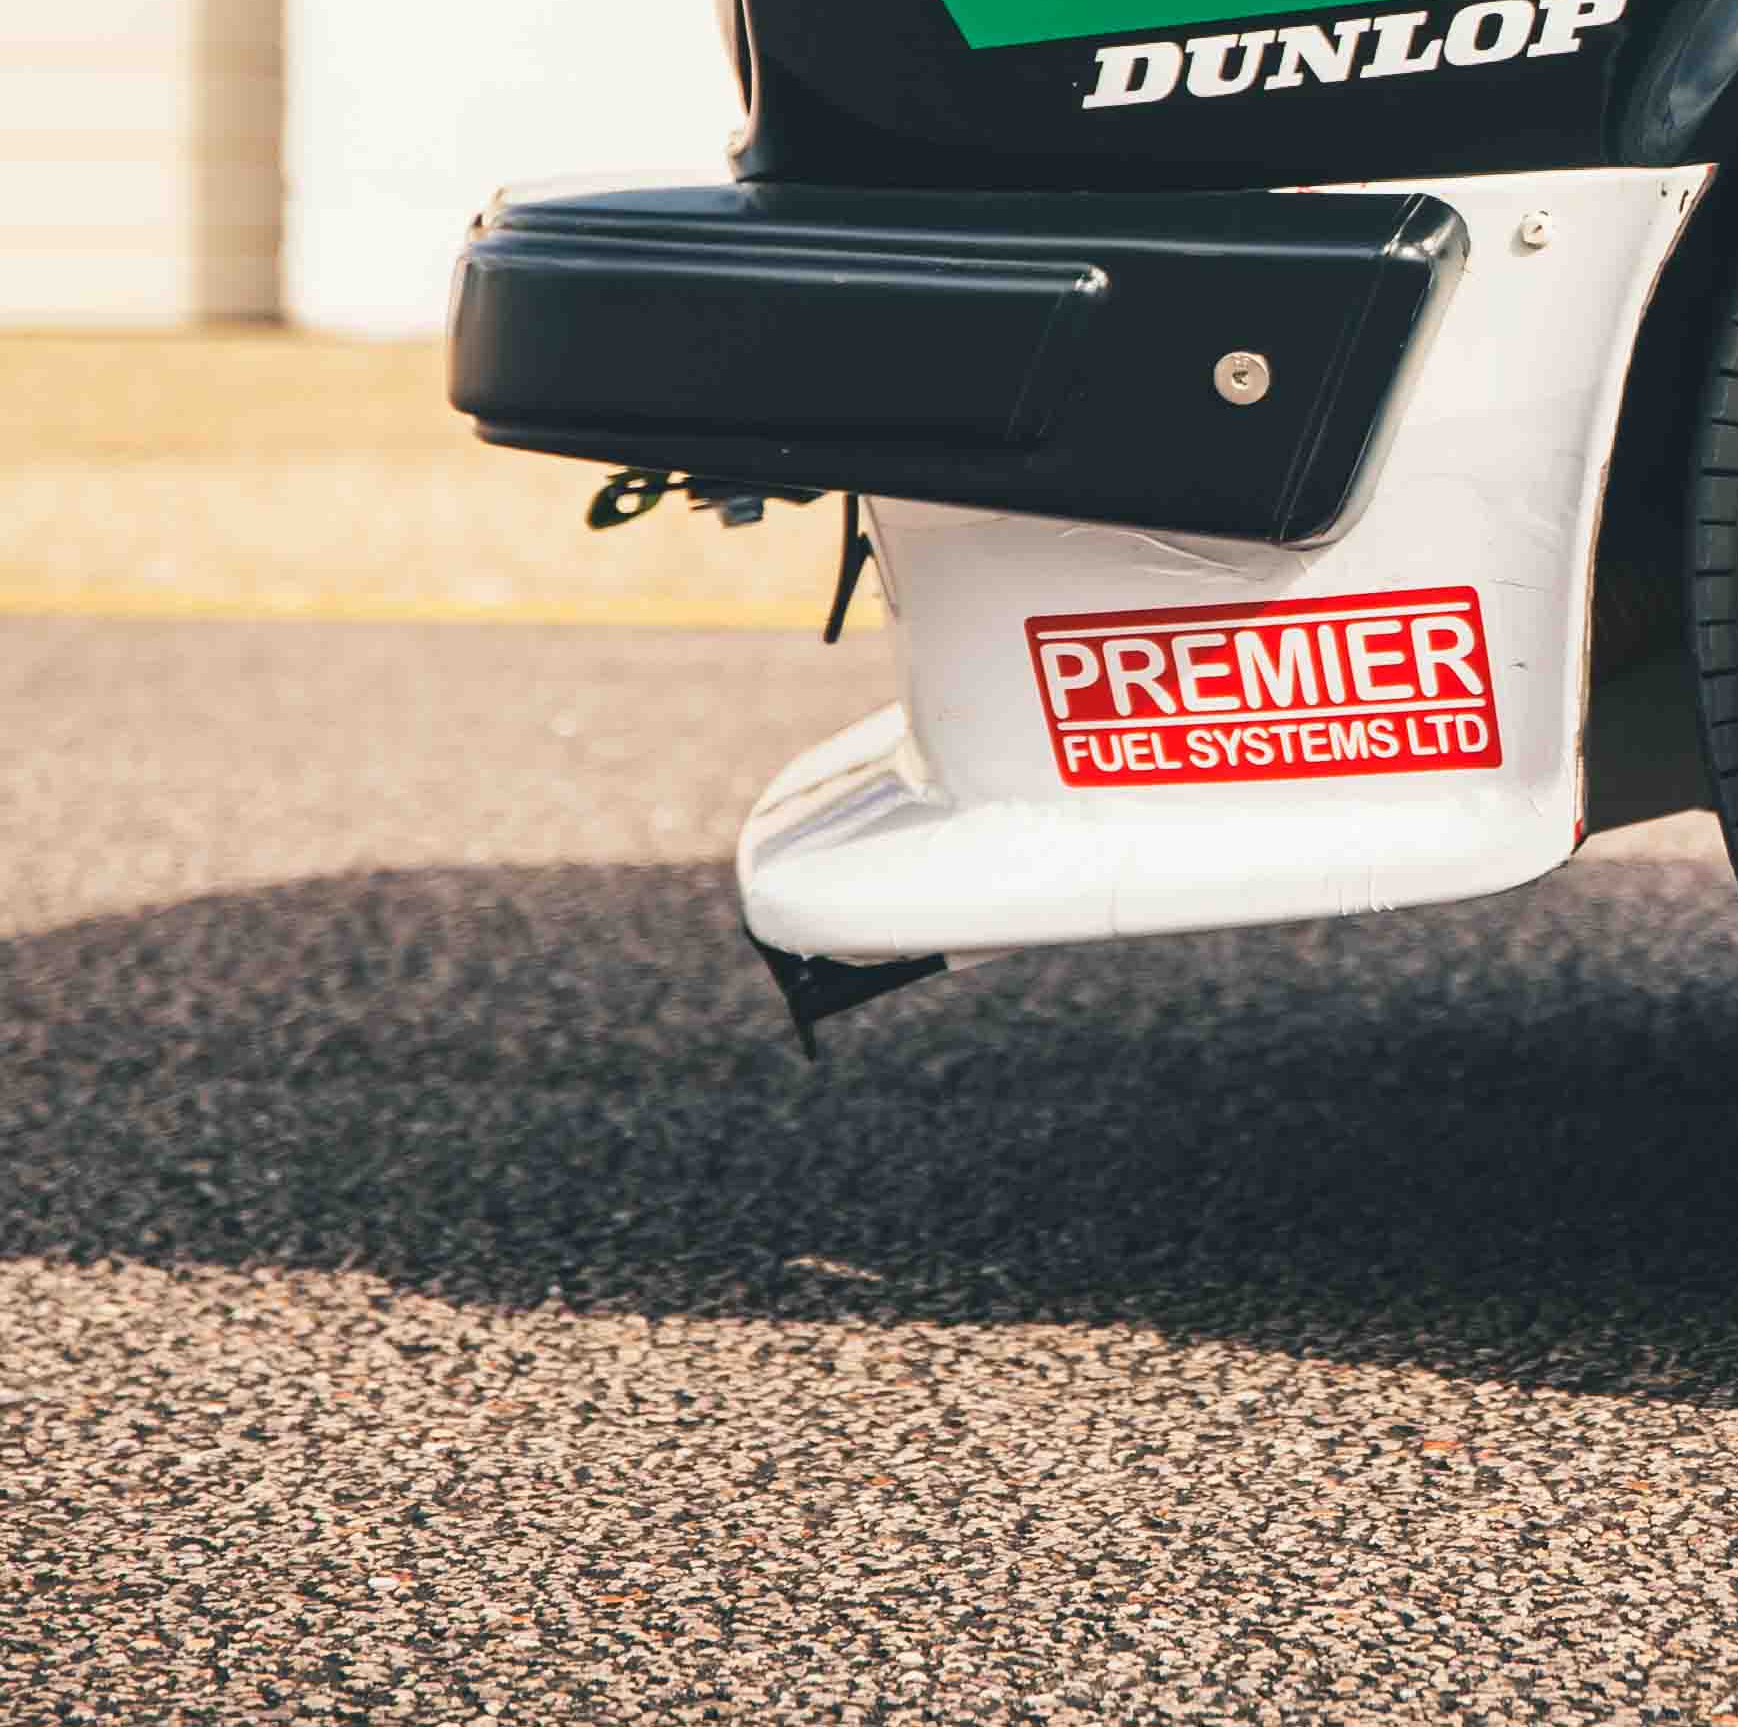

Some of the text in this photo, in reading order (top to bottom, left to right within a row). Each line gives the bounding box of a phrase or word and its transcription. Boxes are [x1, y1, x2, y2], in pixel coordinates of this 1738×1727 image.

[1039, 615, 1486, 720] PREMIER
[1062, 713, 1489, 774] FUEL SYSTEMS LTD
